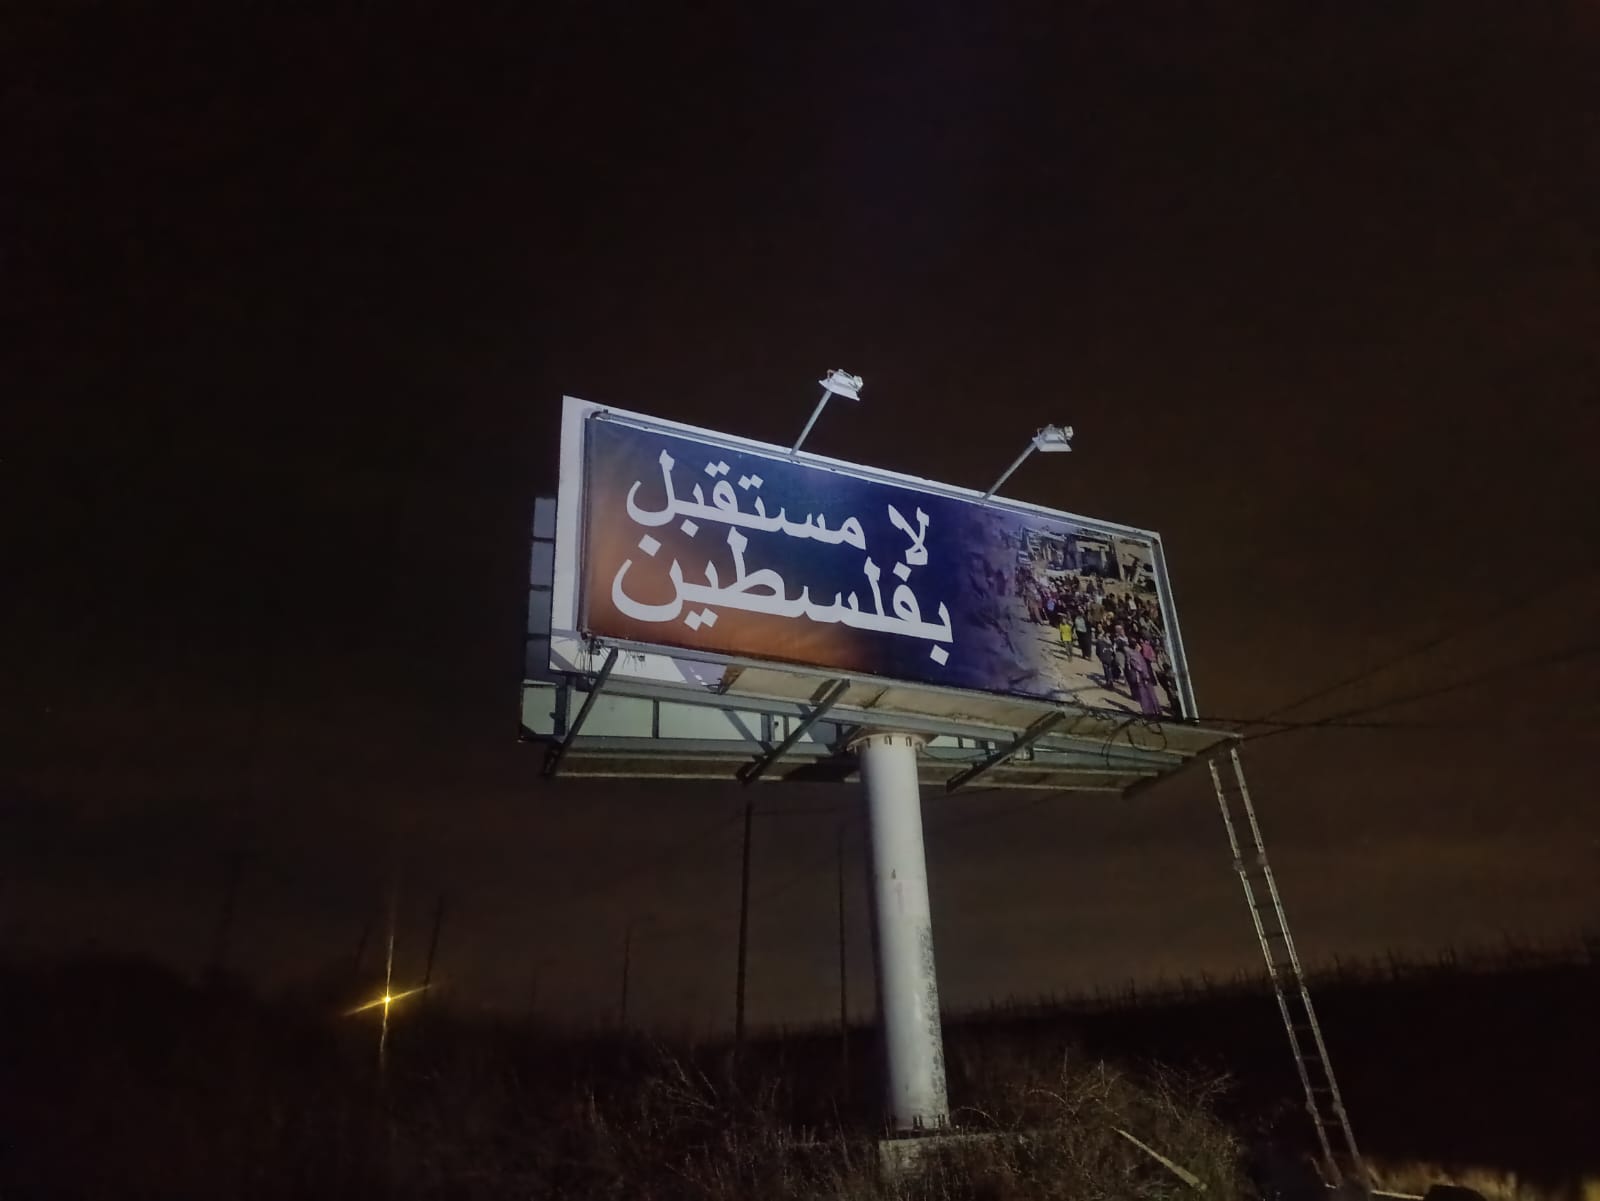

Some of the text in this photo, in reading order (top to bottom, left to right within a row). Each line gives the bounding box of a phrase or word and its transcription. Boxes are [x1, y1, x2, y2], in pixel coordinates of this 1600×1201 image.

[627, 450, 929, 565] لا مستقبل
[612, 527, 952, 665] بفلسطين
